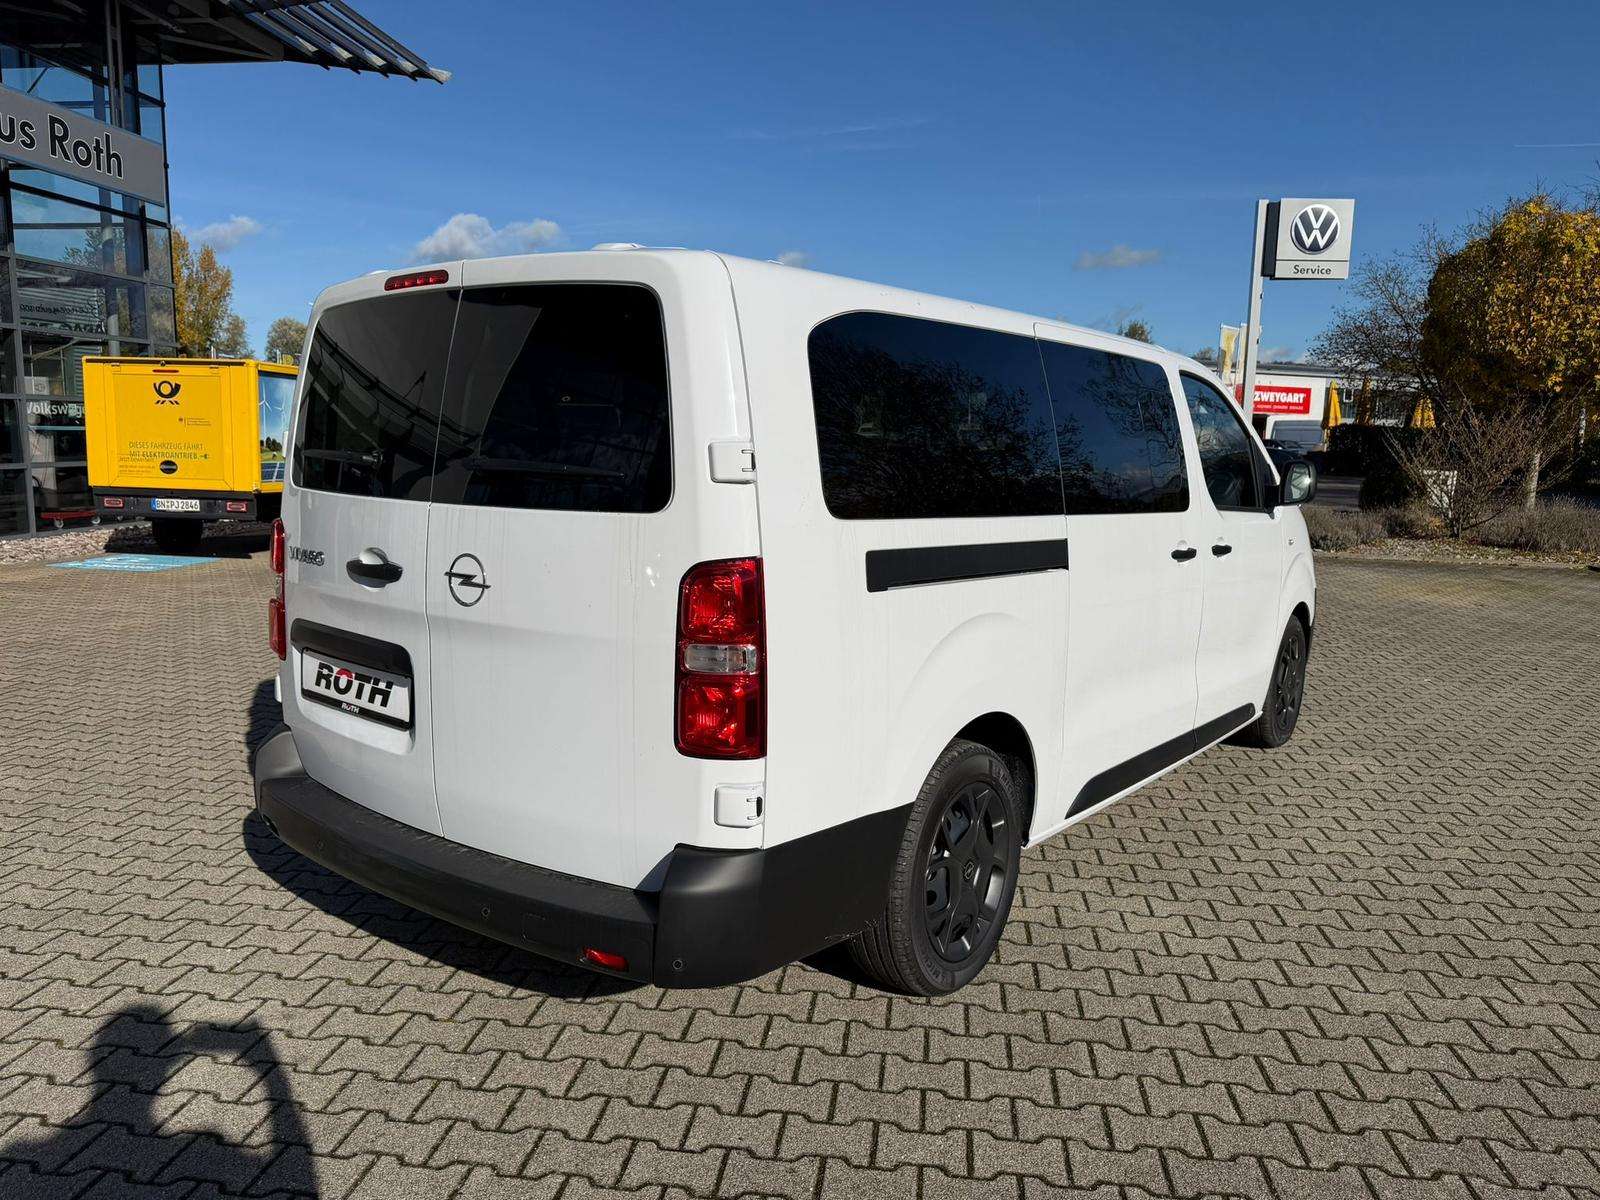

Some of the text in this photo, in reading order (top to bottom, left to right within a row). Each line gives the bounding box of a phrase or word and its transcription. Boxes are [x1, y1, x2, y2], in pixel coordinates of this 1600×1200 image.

[47, 113, 124, 180] Roth
[1293, 264, 1332, 275] Service
[1253, 390, 1305, 403] ZWEYGART
[128, 441, 149, 449] DIESES
[315, 661, 394, 708] ROTH
[341, 701, 360, 714] ROTH
